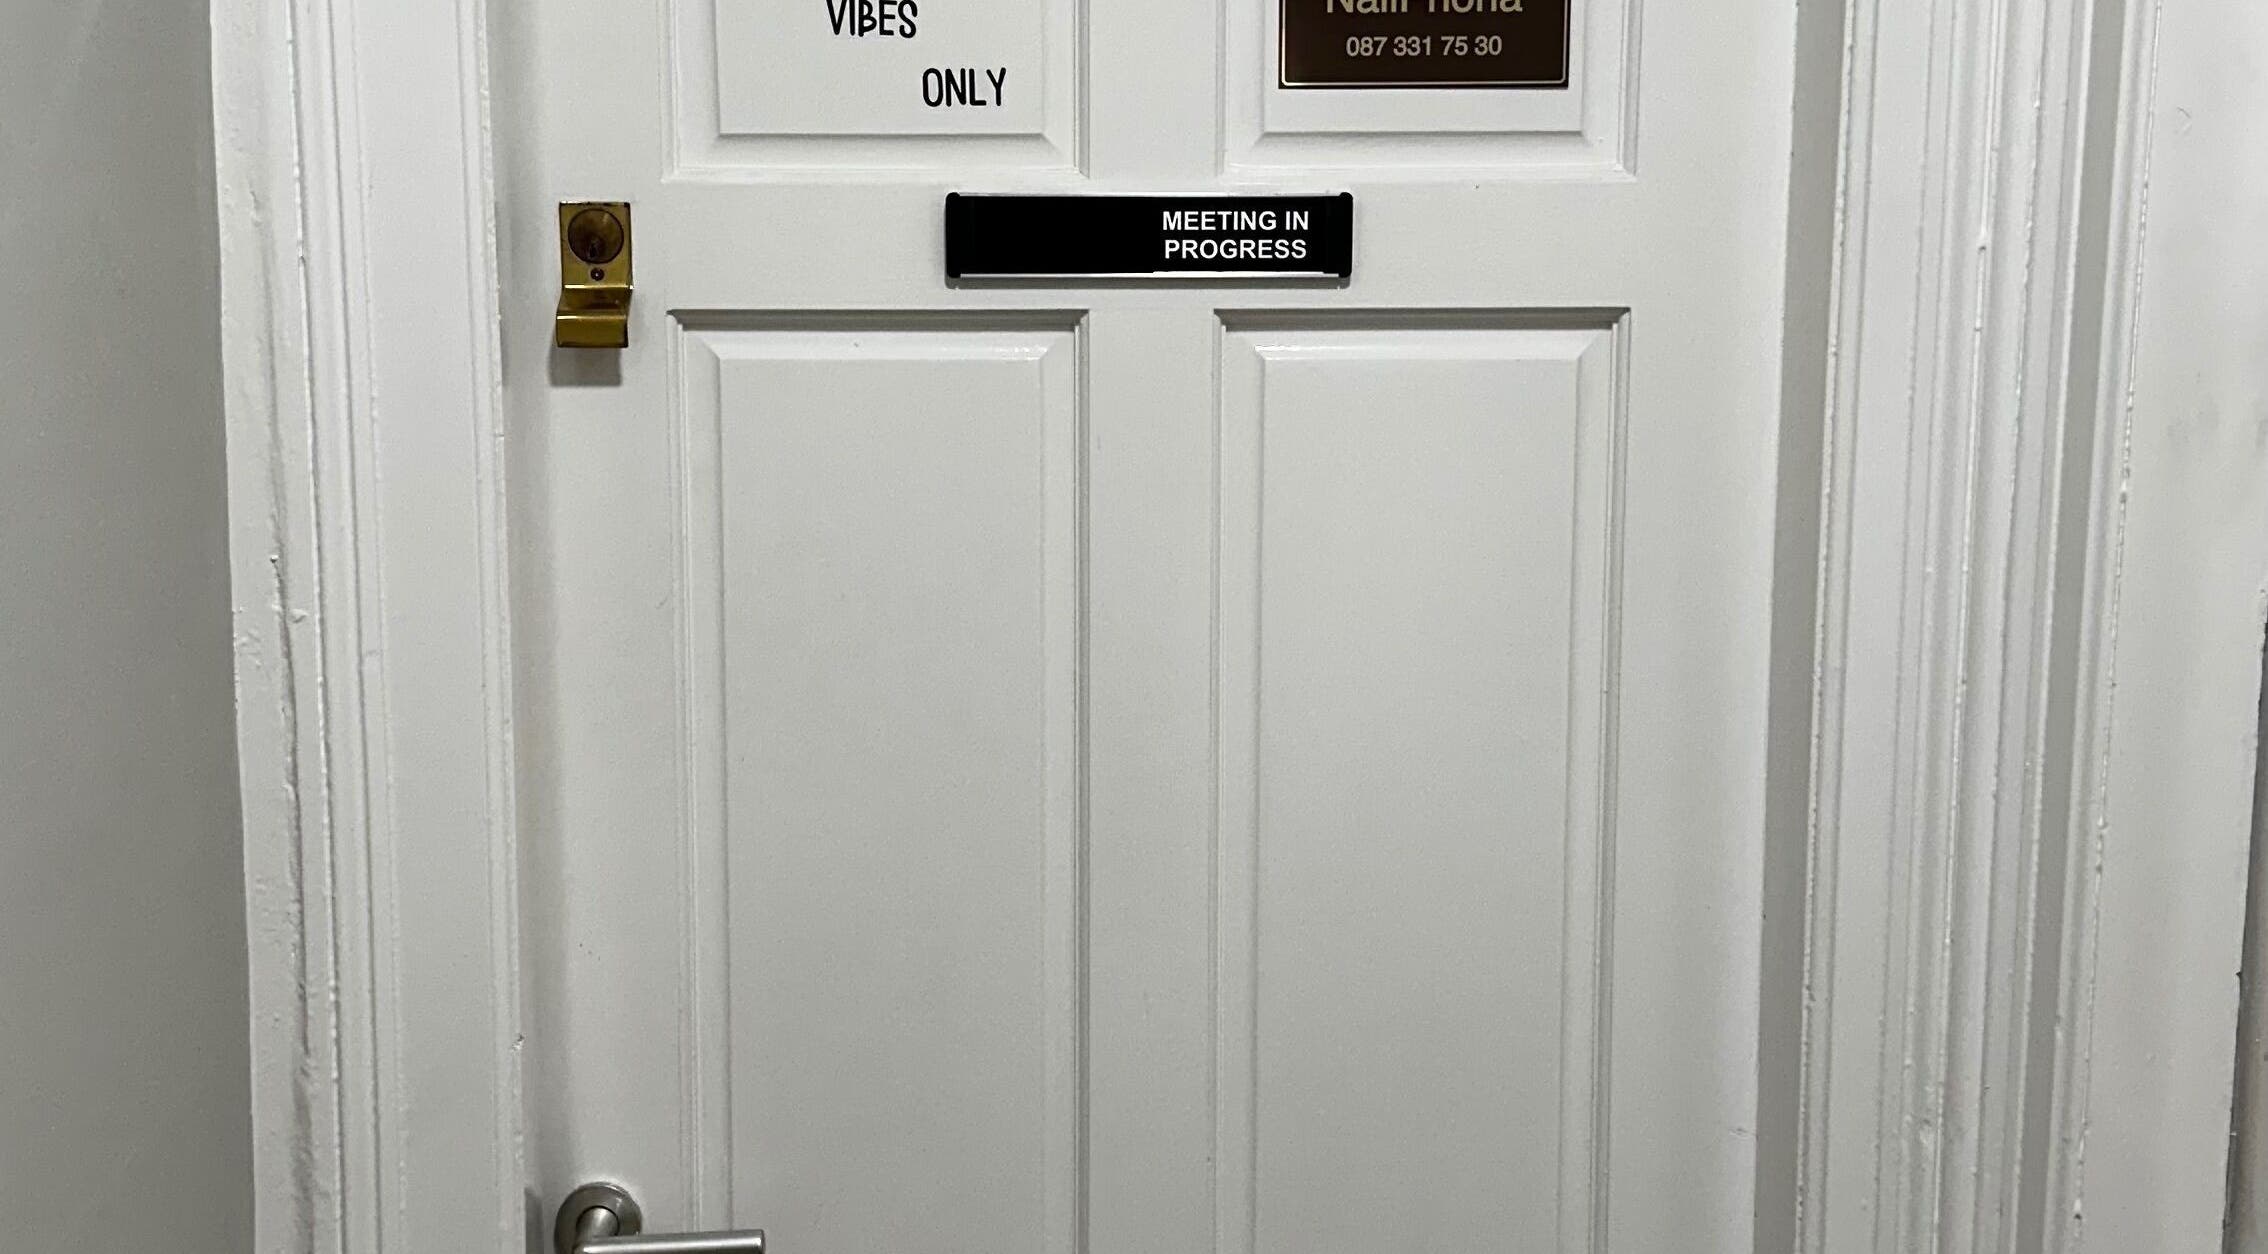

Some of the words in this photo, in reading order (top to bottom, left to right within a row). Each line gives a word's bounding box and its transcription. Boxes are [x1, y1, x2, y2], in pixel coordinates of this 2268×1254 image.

[826, 0, 918, 39] VIBES
[1346, 36, 1388, 57] 087
[1393, 36, 1431, 56] 331
[1440, 36, 1469, 56] 75
[1474, 36, 1503, 56] 30
[922, 67, 1007, 107] ONLY
[1162, 210, 1277, 231] MEETING
[1285, 210, 1309, 231] IN
[1164, 239, 1307, 259] PROGRESS
